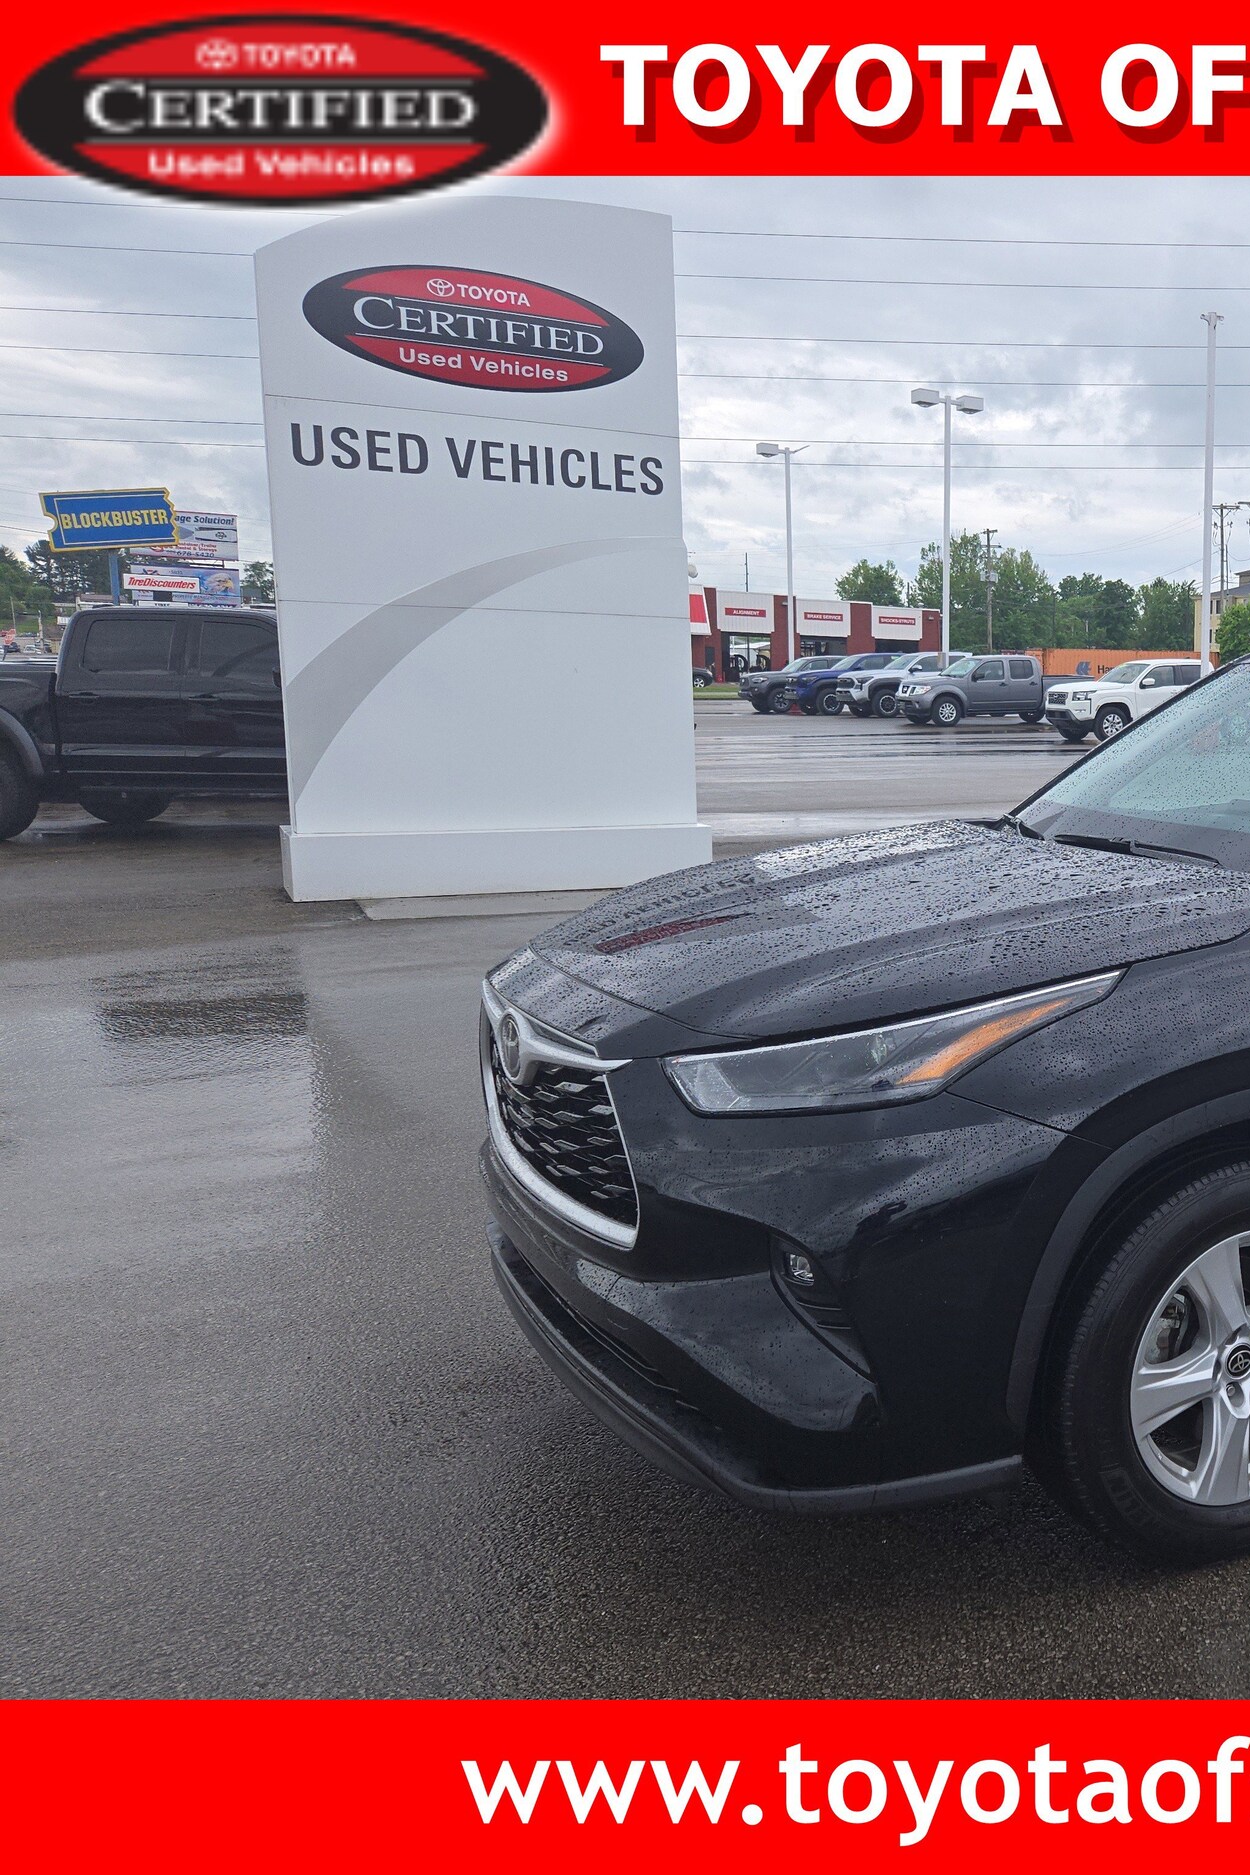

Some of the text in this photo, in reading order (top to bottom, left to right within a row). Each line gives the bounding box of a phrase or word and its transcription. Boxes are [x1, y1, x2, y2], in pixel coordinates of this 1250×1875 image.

[456, 283, 531, 307] TOYOTA
[353, 296, 604, 355] CERTIFIED
[399, 347, 569, 382] Used Vehicles
[290, 423, 664, 496] USED VEHICLES
[60, 509, 169, 530] BLOCKBUSTER
[193, 515, 235, 525] Solution!
[128, 576, 196, 589] TireDiscounters
[732, 609, 760, 617] ALIGNMENT
